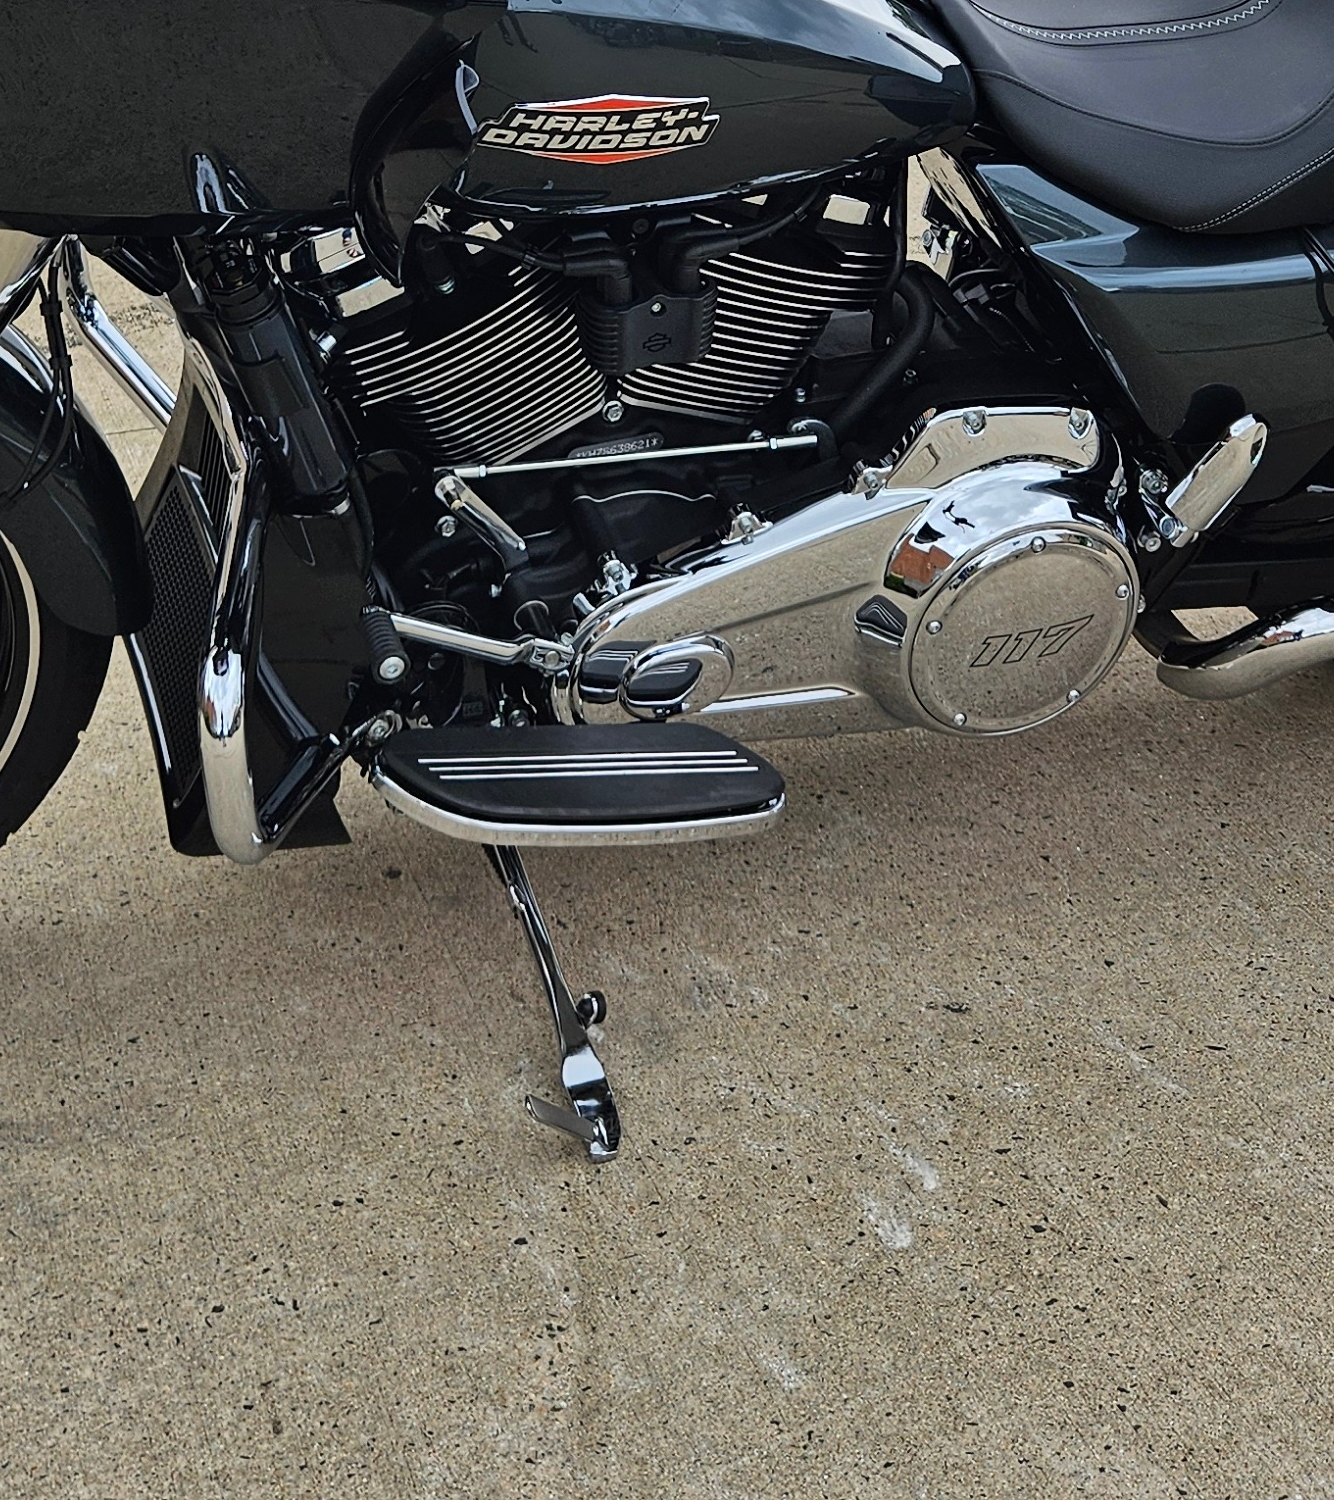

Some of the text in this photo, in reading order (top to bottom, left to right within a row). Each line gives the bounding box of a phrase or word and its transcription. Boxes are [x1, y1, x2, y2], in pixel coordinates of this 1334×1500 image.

[508, 108, 699, 133] HARLEY-
[481, 123, 709, 150] DAVIDSON
[968, 613, 1095, 668] 117
